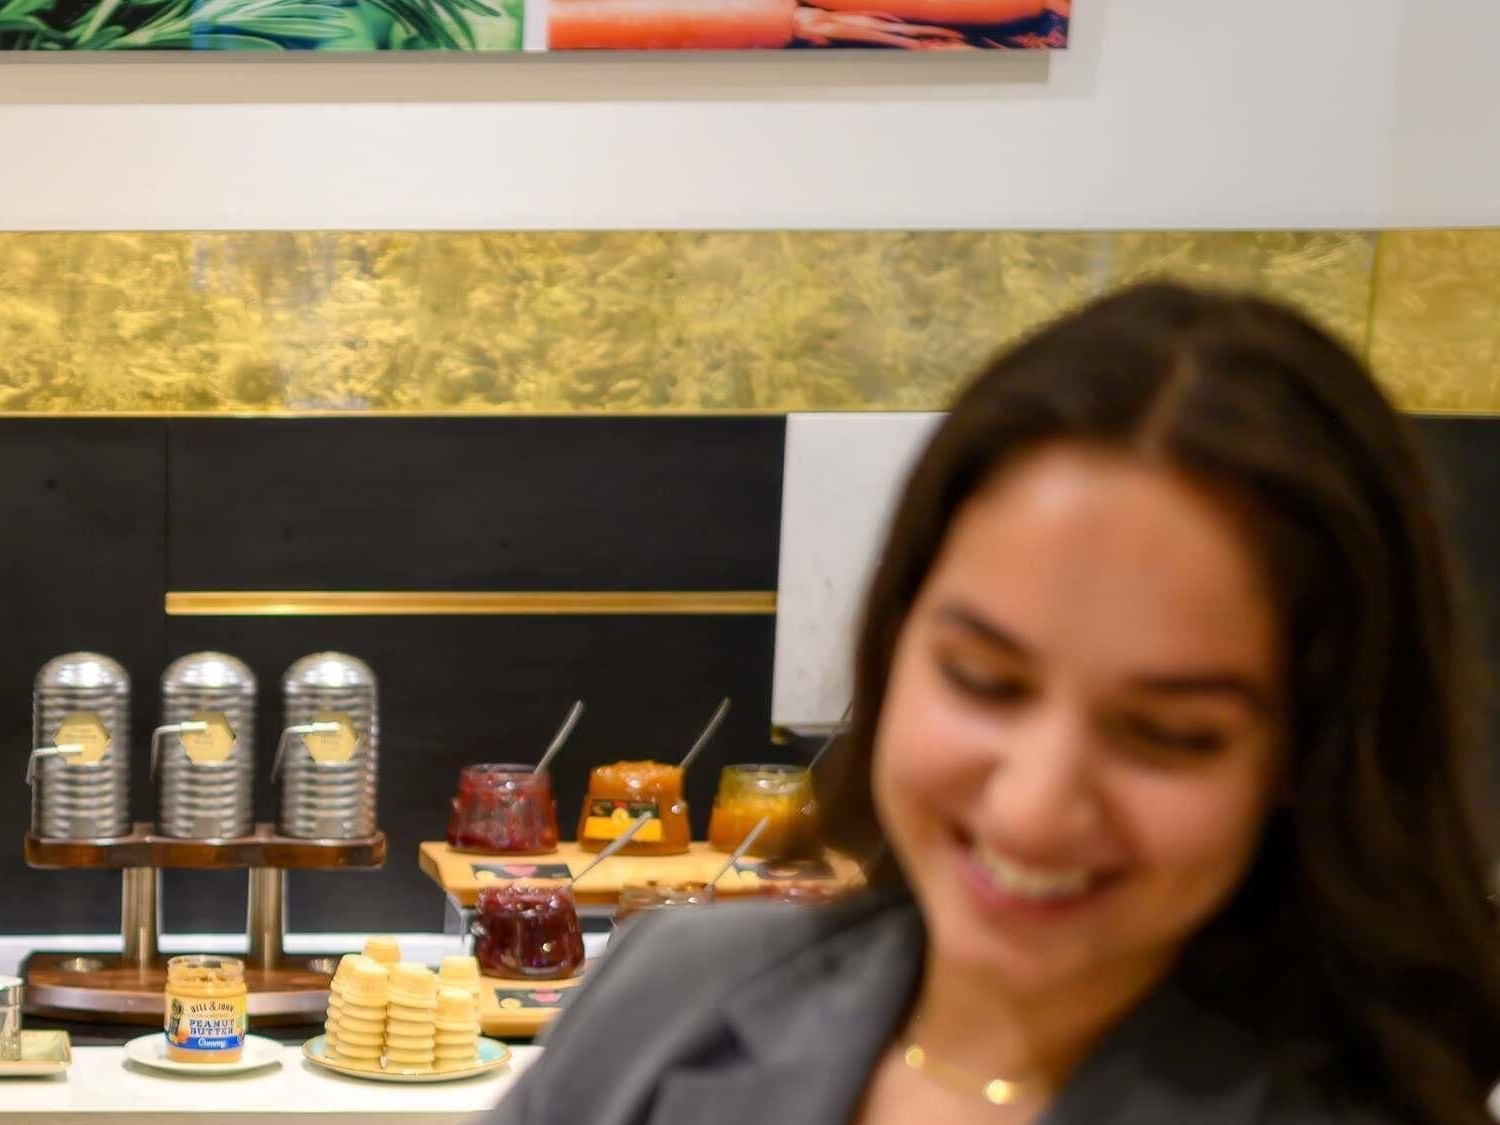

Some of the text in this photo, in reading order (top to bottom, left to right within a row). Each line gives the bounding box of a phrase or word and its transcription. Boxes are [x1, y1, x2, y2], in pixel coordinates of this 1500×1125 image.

[189, 1019, 234, 1027] PEANUT
[190, 1027, 233, 1036] BUTTER
[197, 1037, 226, 1049] Creamy
